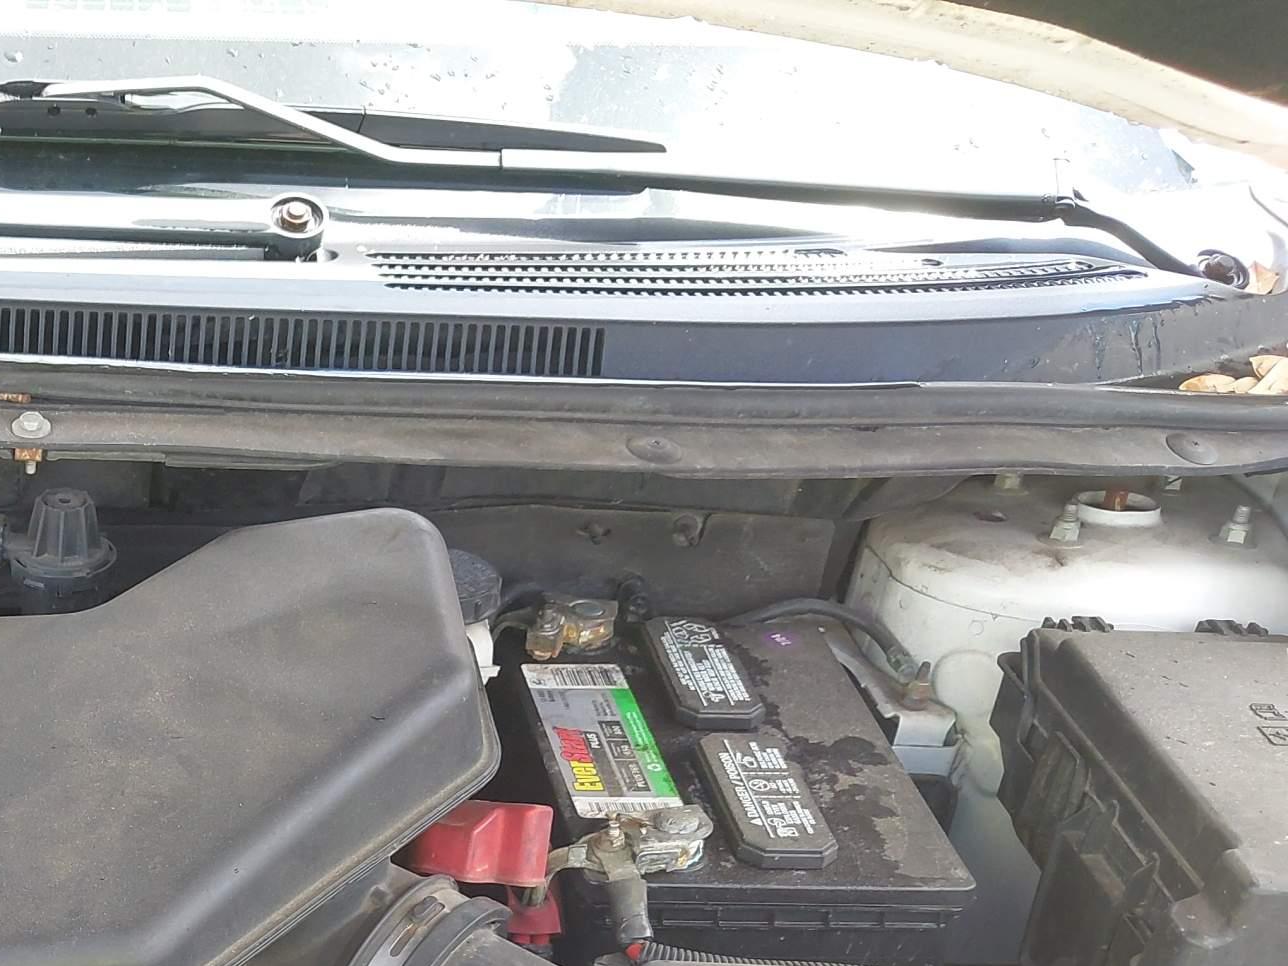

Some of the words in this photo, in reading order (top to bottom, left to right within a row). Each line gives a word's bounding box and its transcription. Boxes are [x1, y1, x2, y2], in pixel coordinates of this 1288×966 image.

[552, 726, 605, 793] EverStart
[718, 751, 741, 781] POISON
[735, 784, 760, 819] DANGER
